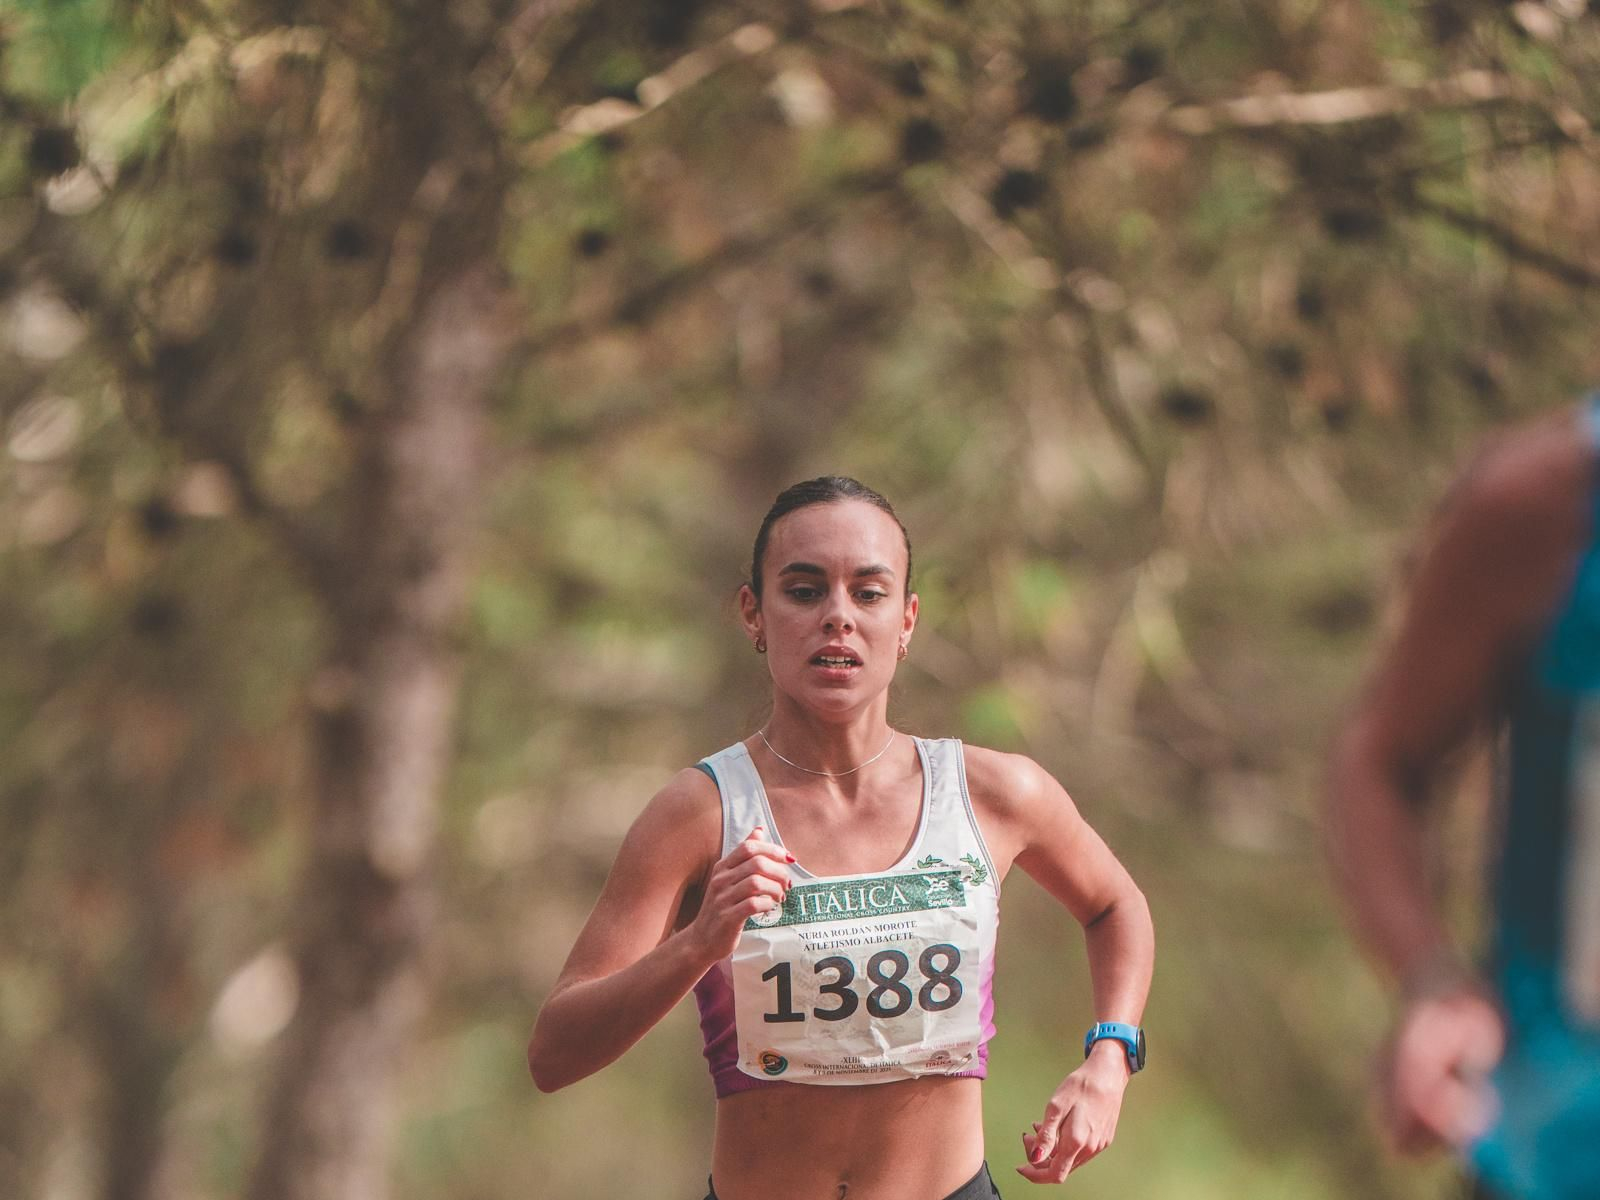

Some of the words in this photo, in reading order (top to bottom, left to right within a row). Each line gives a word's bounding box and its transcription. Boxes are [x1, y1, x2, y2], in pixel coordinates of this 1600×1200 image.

[799, 885, 910, 916] ITÁLICA
[801, 911, 853, 922] INTERNATIONAL
[856, 909, 877, 918] CROSS
[878, 905, 911, 915] COUNTRY
[874, 921, 918, 932] MOROTE
[804, 938, 861, 952] ATLETISMO
[863, 932, 915, 945] ALBACETE
[761, 943, 963, 1024] 1388
